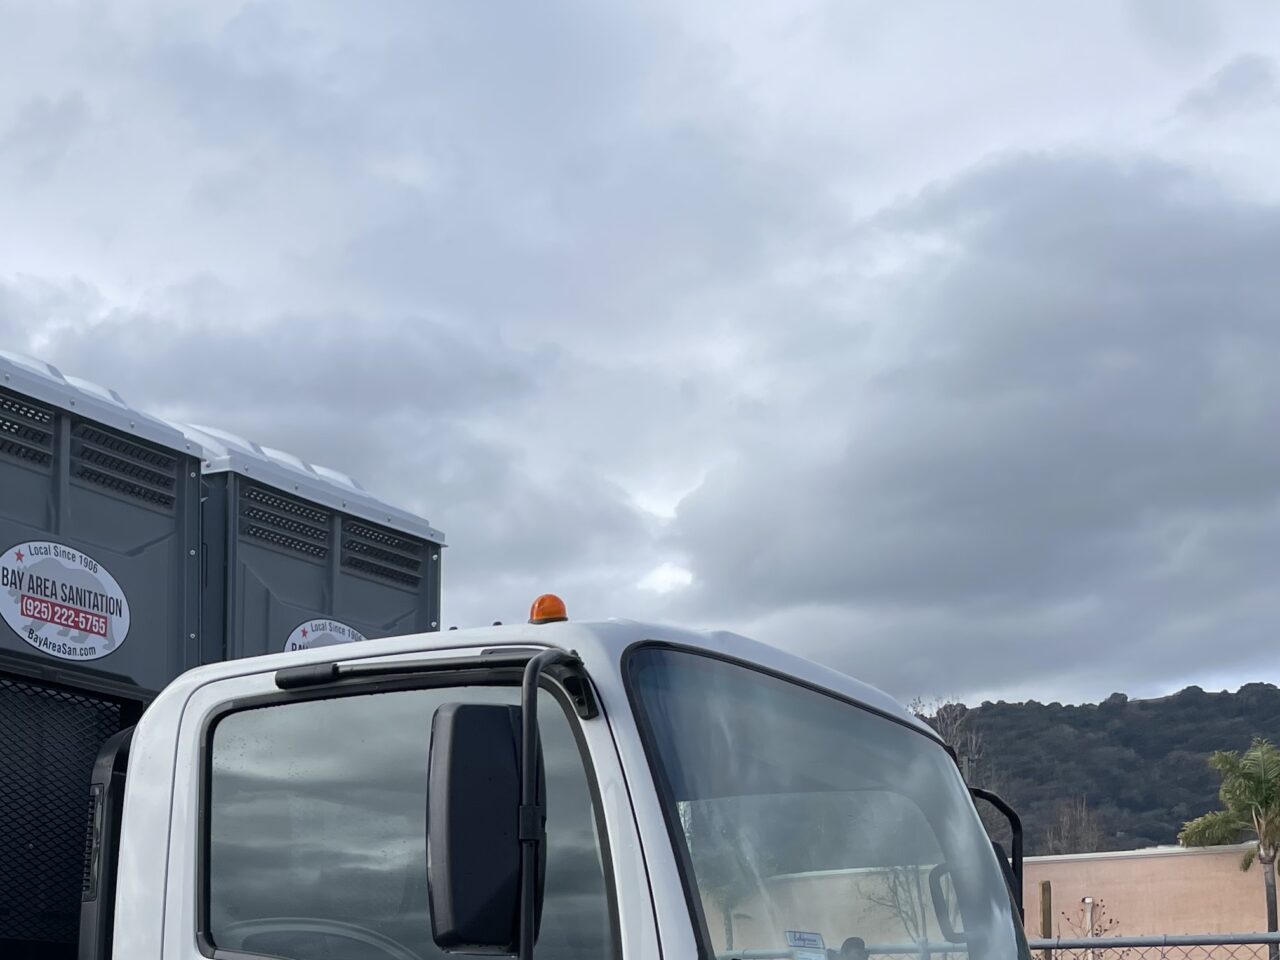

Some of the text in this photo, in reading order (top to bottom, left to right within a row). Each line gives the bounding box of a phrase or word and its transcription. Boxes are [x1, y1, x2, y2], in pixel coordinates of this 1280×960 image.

[28, 544, 98, 574] Local Since 1906
[1, 566, 122, 618] BAY AREA SANITATION
[22, 596, 106, 634] (925) 222-5755
[310, 621, 327, 633] Local
[328, 622, 346, 636] Since
[27, 628, 96, 656] BayAreaSan.com
